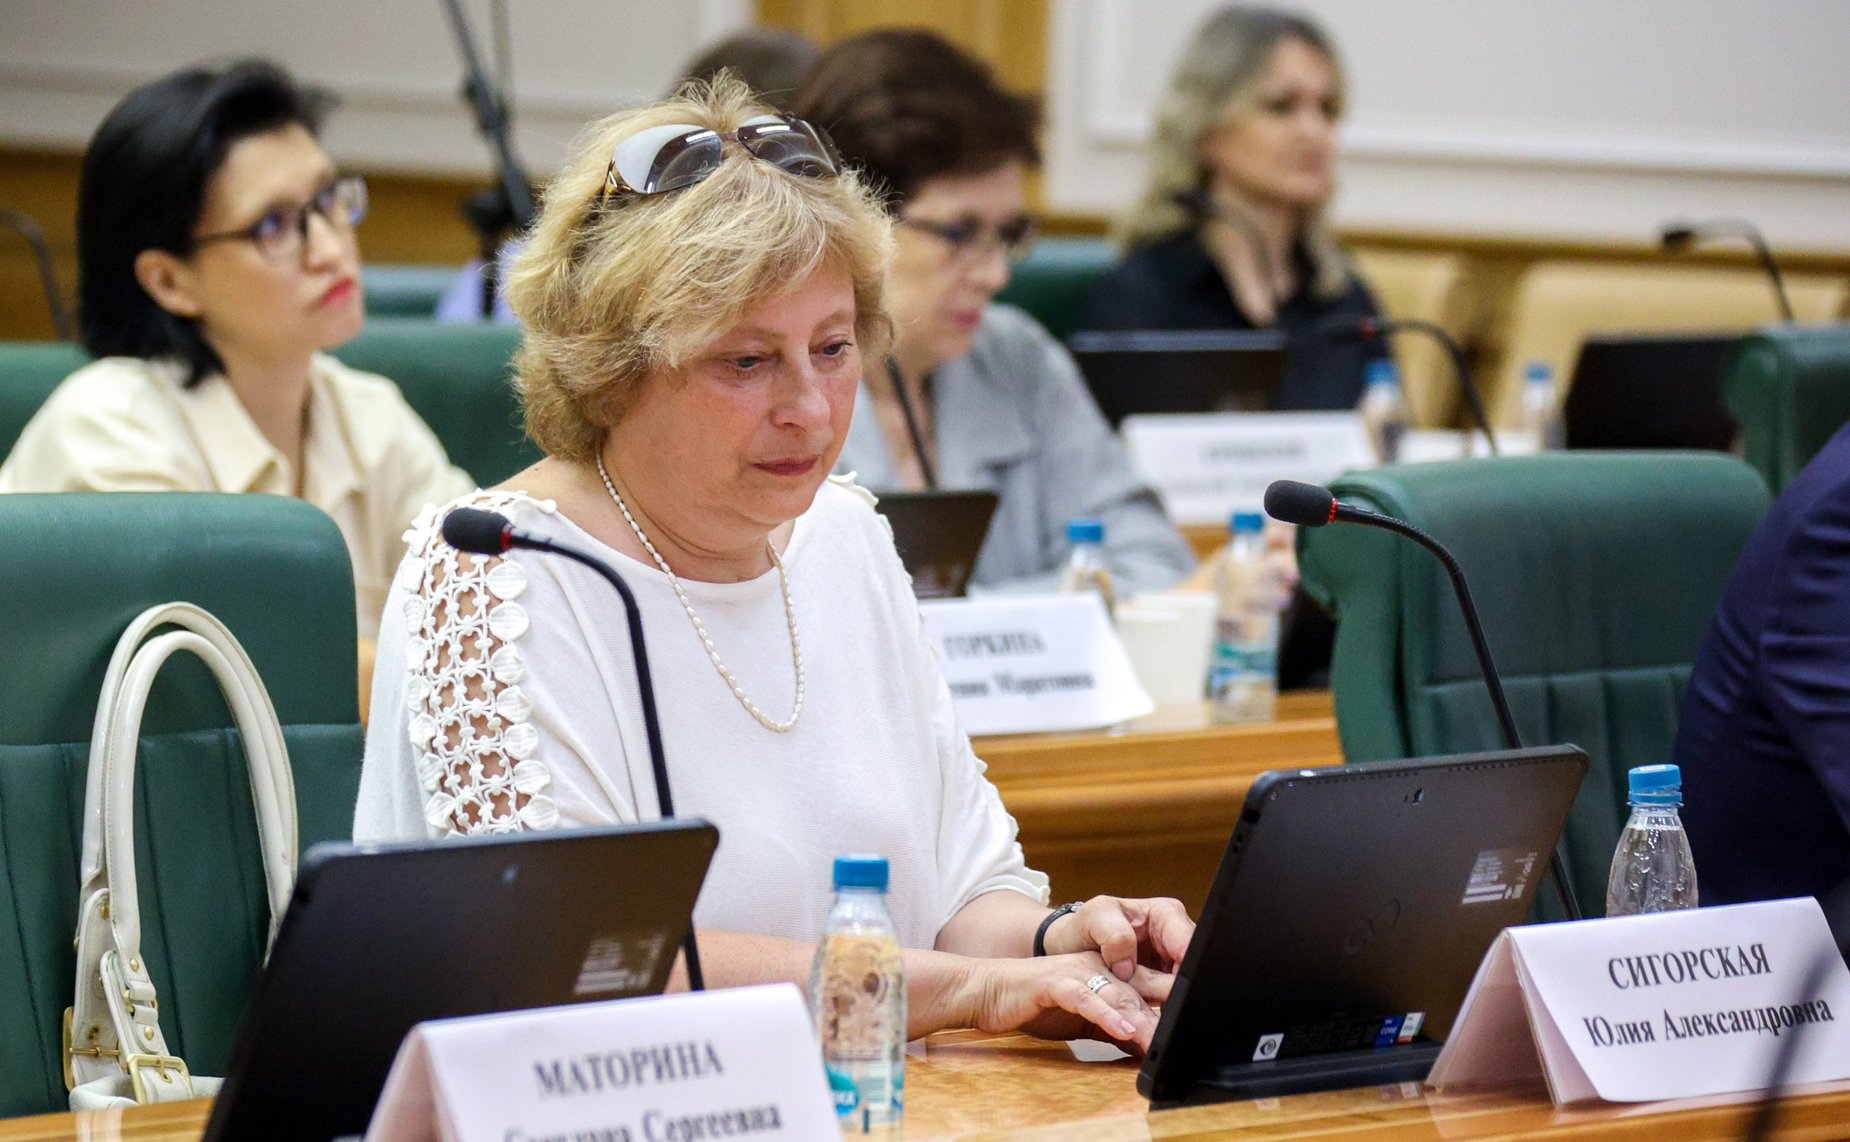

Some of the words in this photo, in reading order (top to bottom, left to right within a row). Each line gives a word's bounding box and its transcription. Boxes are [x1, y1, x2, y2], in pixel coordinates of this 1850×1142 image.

[1608, 943, 1772, 990] СИГОРСКАЯ
[1583, 1015, 1656, 1047] Юлия
[1664, 999, 1835, 1040] Александровна
[535, 1039, 724, 1097] МАТОРИНА
[642, 1105, 782, 1142] Сергеевна
